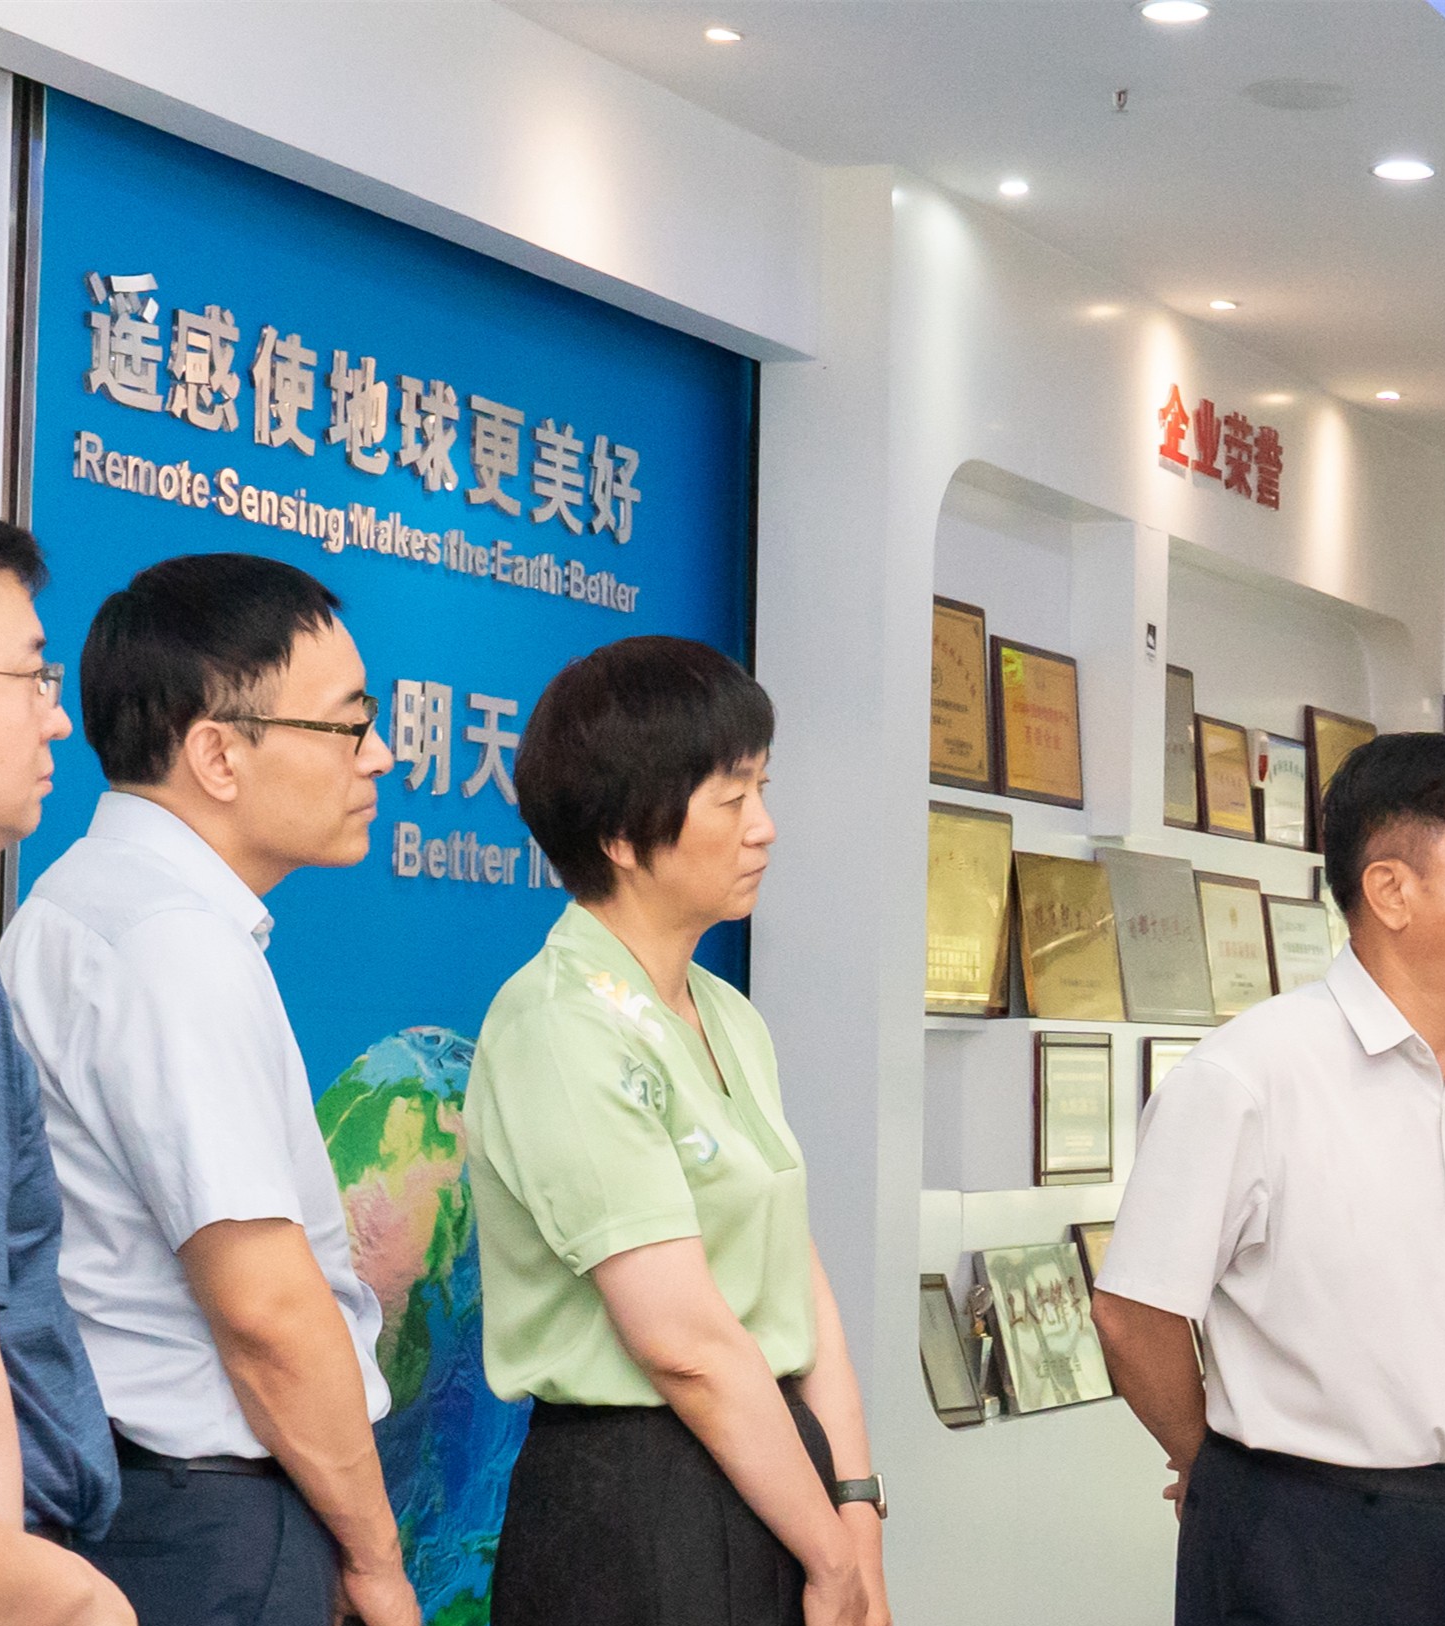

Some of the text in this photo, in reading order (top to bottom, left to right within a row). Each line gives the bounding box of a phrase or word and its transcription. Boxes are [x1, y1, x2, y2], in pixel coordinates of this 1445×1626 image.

[85, 271, 642, 546] 遥感使地球更美好
[1158, 383, 1283, 510] 企业荣誉
[73, 430, 640, 613] Remote Sensing Makes the Earth Better
[390, 678, 521, 806] 明天
[392, 821, 521, 885] Better
